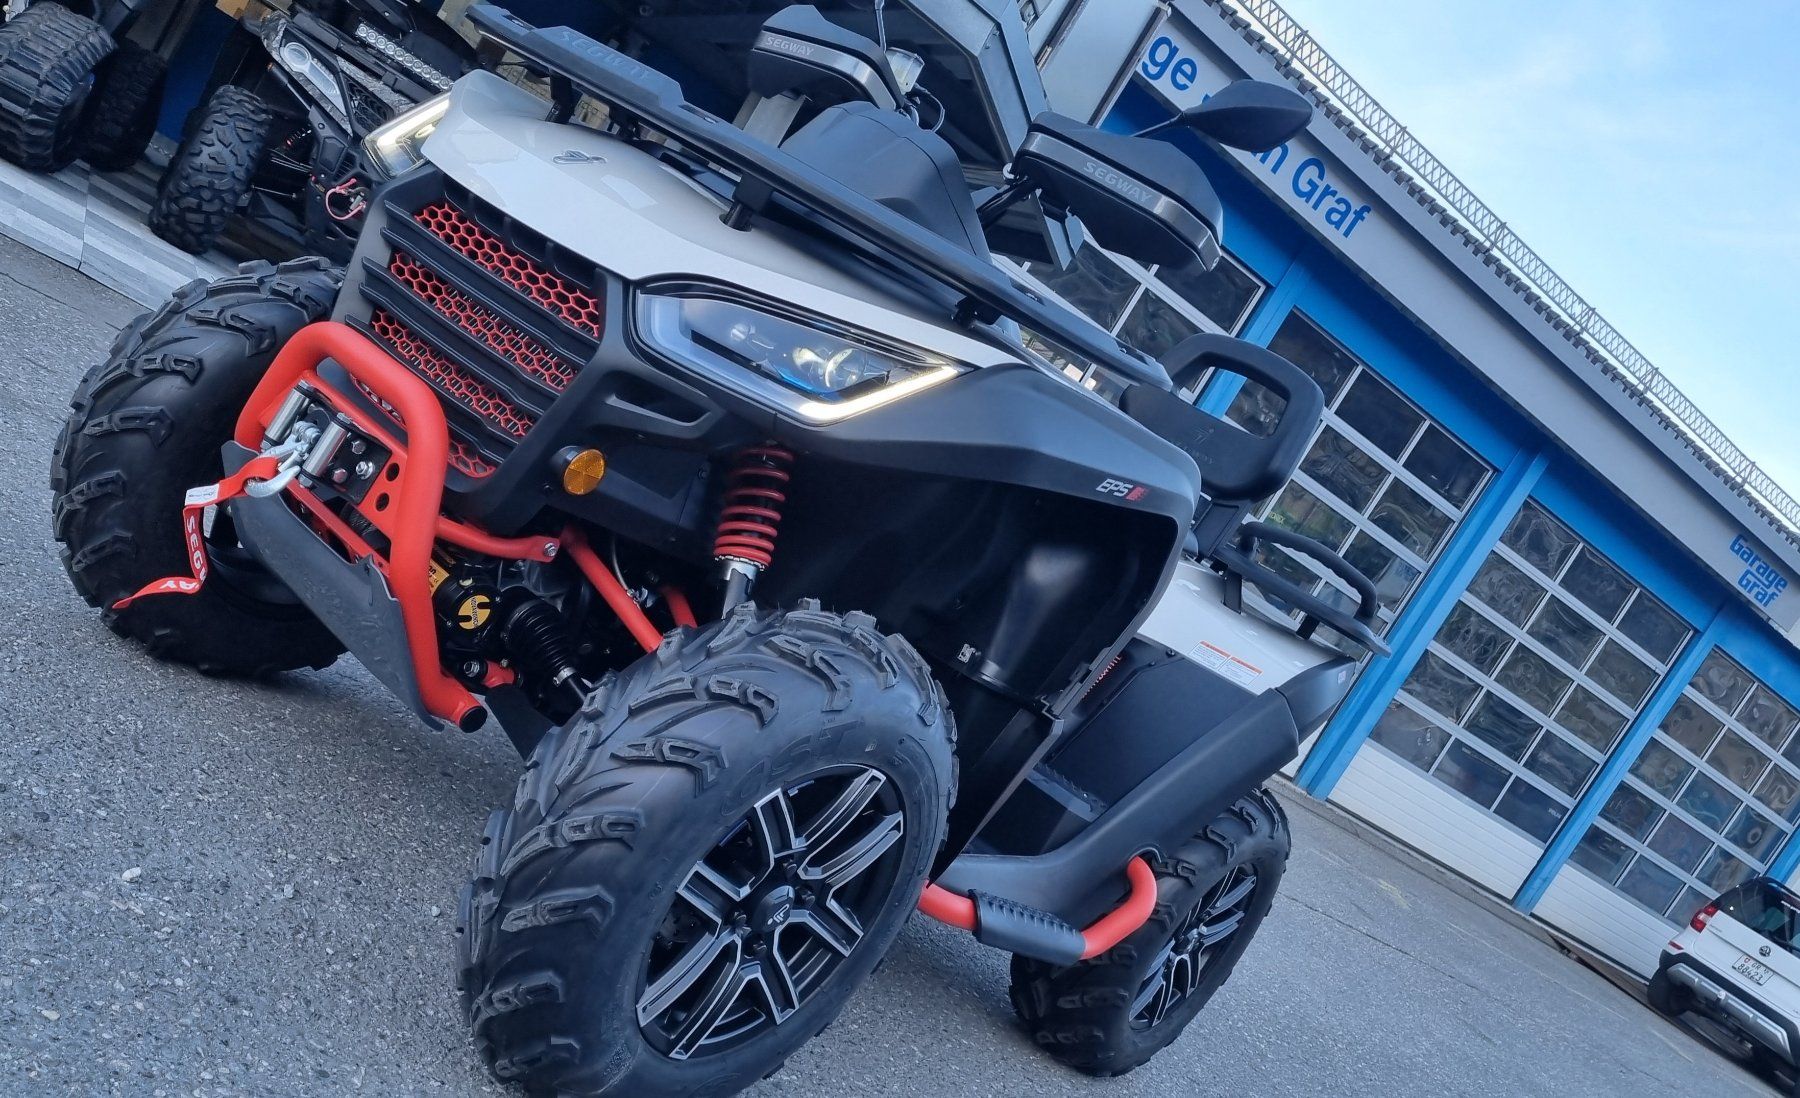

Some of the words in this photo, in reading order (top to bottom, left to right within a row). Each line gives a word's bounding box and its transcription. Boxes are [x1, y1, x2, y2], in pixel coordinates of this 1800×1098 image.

[766, 36, 815, 56] SEGWAY
[1083, 161, 1153, 202] SEGWAY
[1292, 157, 1372, 238] Graf
[1096, 478, 1134, 497] EPS
[1729, 533, 1788, 593] Garage
[1738, 568, 1779, 608] Graf
